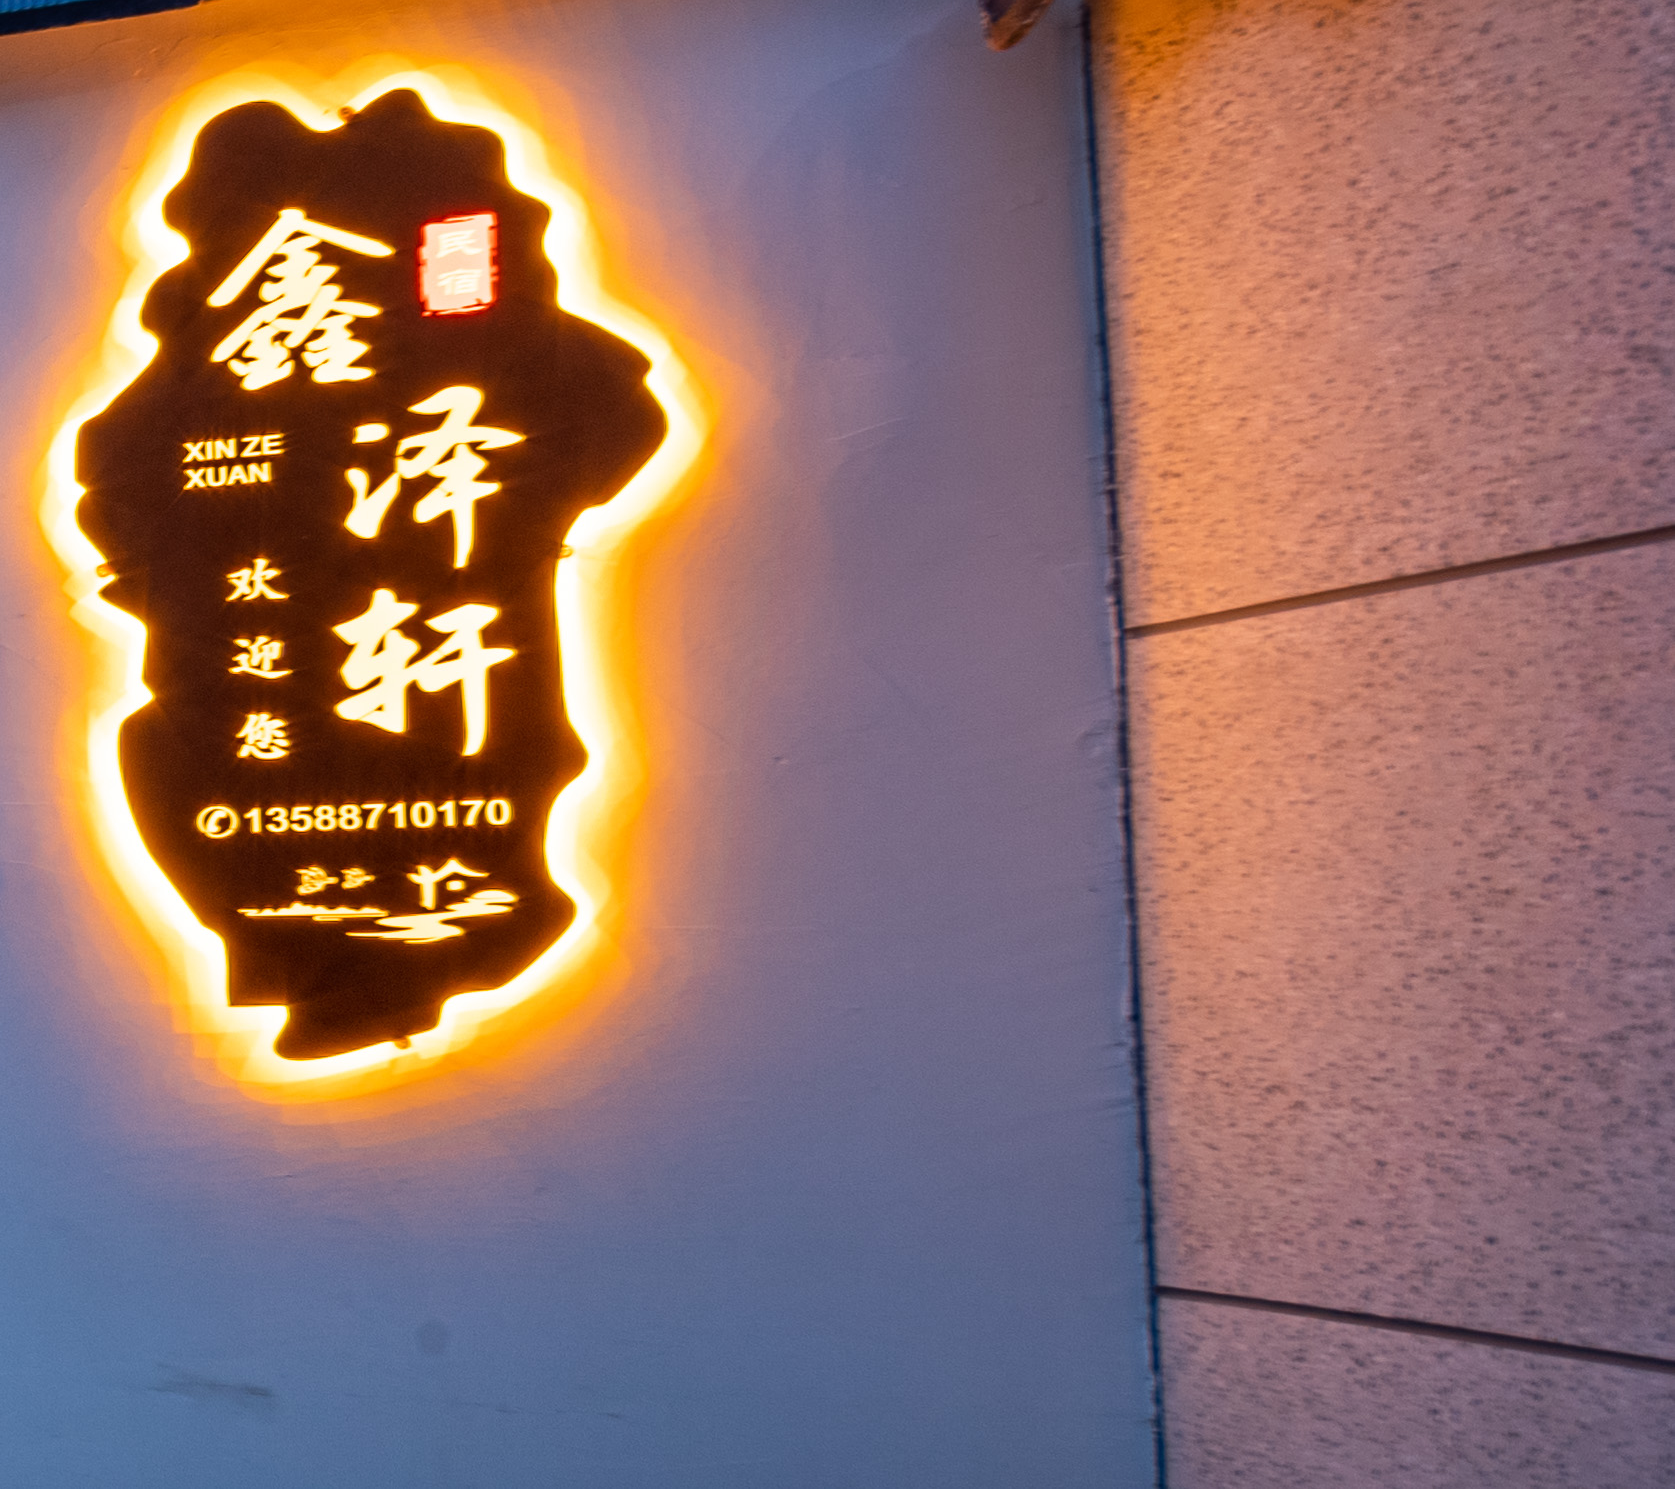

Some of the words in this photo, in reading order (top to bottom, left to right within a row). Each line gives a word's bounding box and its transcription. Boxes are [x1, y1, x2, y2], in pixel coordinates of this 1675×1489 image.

[434, 229, 484, 296] 民宿
[182, 438, 237, 463] XIN
[240, 433, 286, 458] ZE
[183, 462, 273, 490] XUAN
[226, 558, 294, 760] 欢迎您
[243, 798, 513, 834] 13588710170
